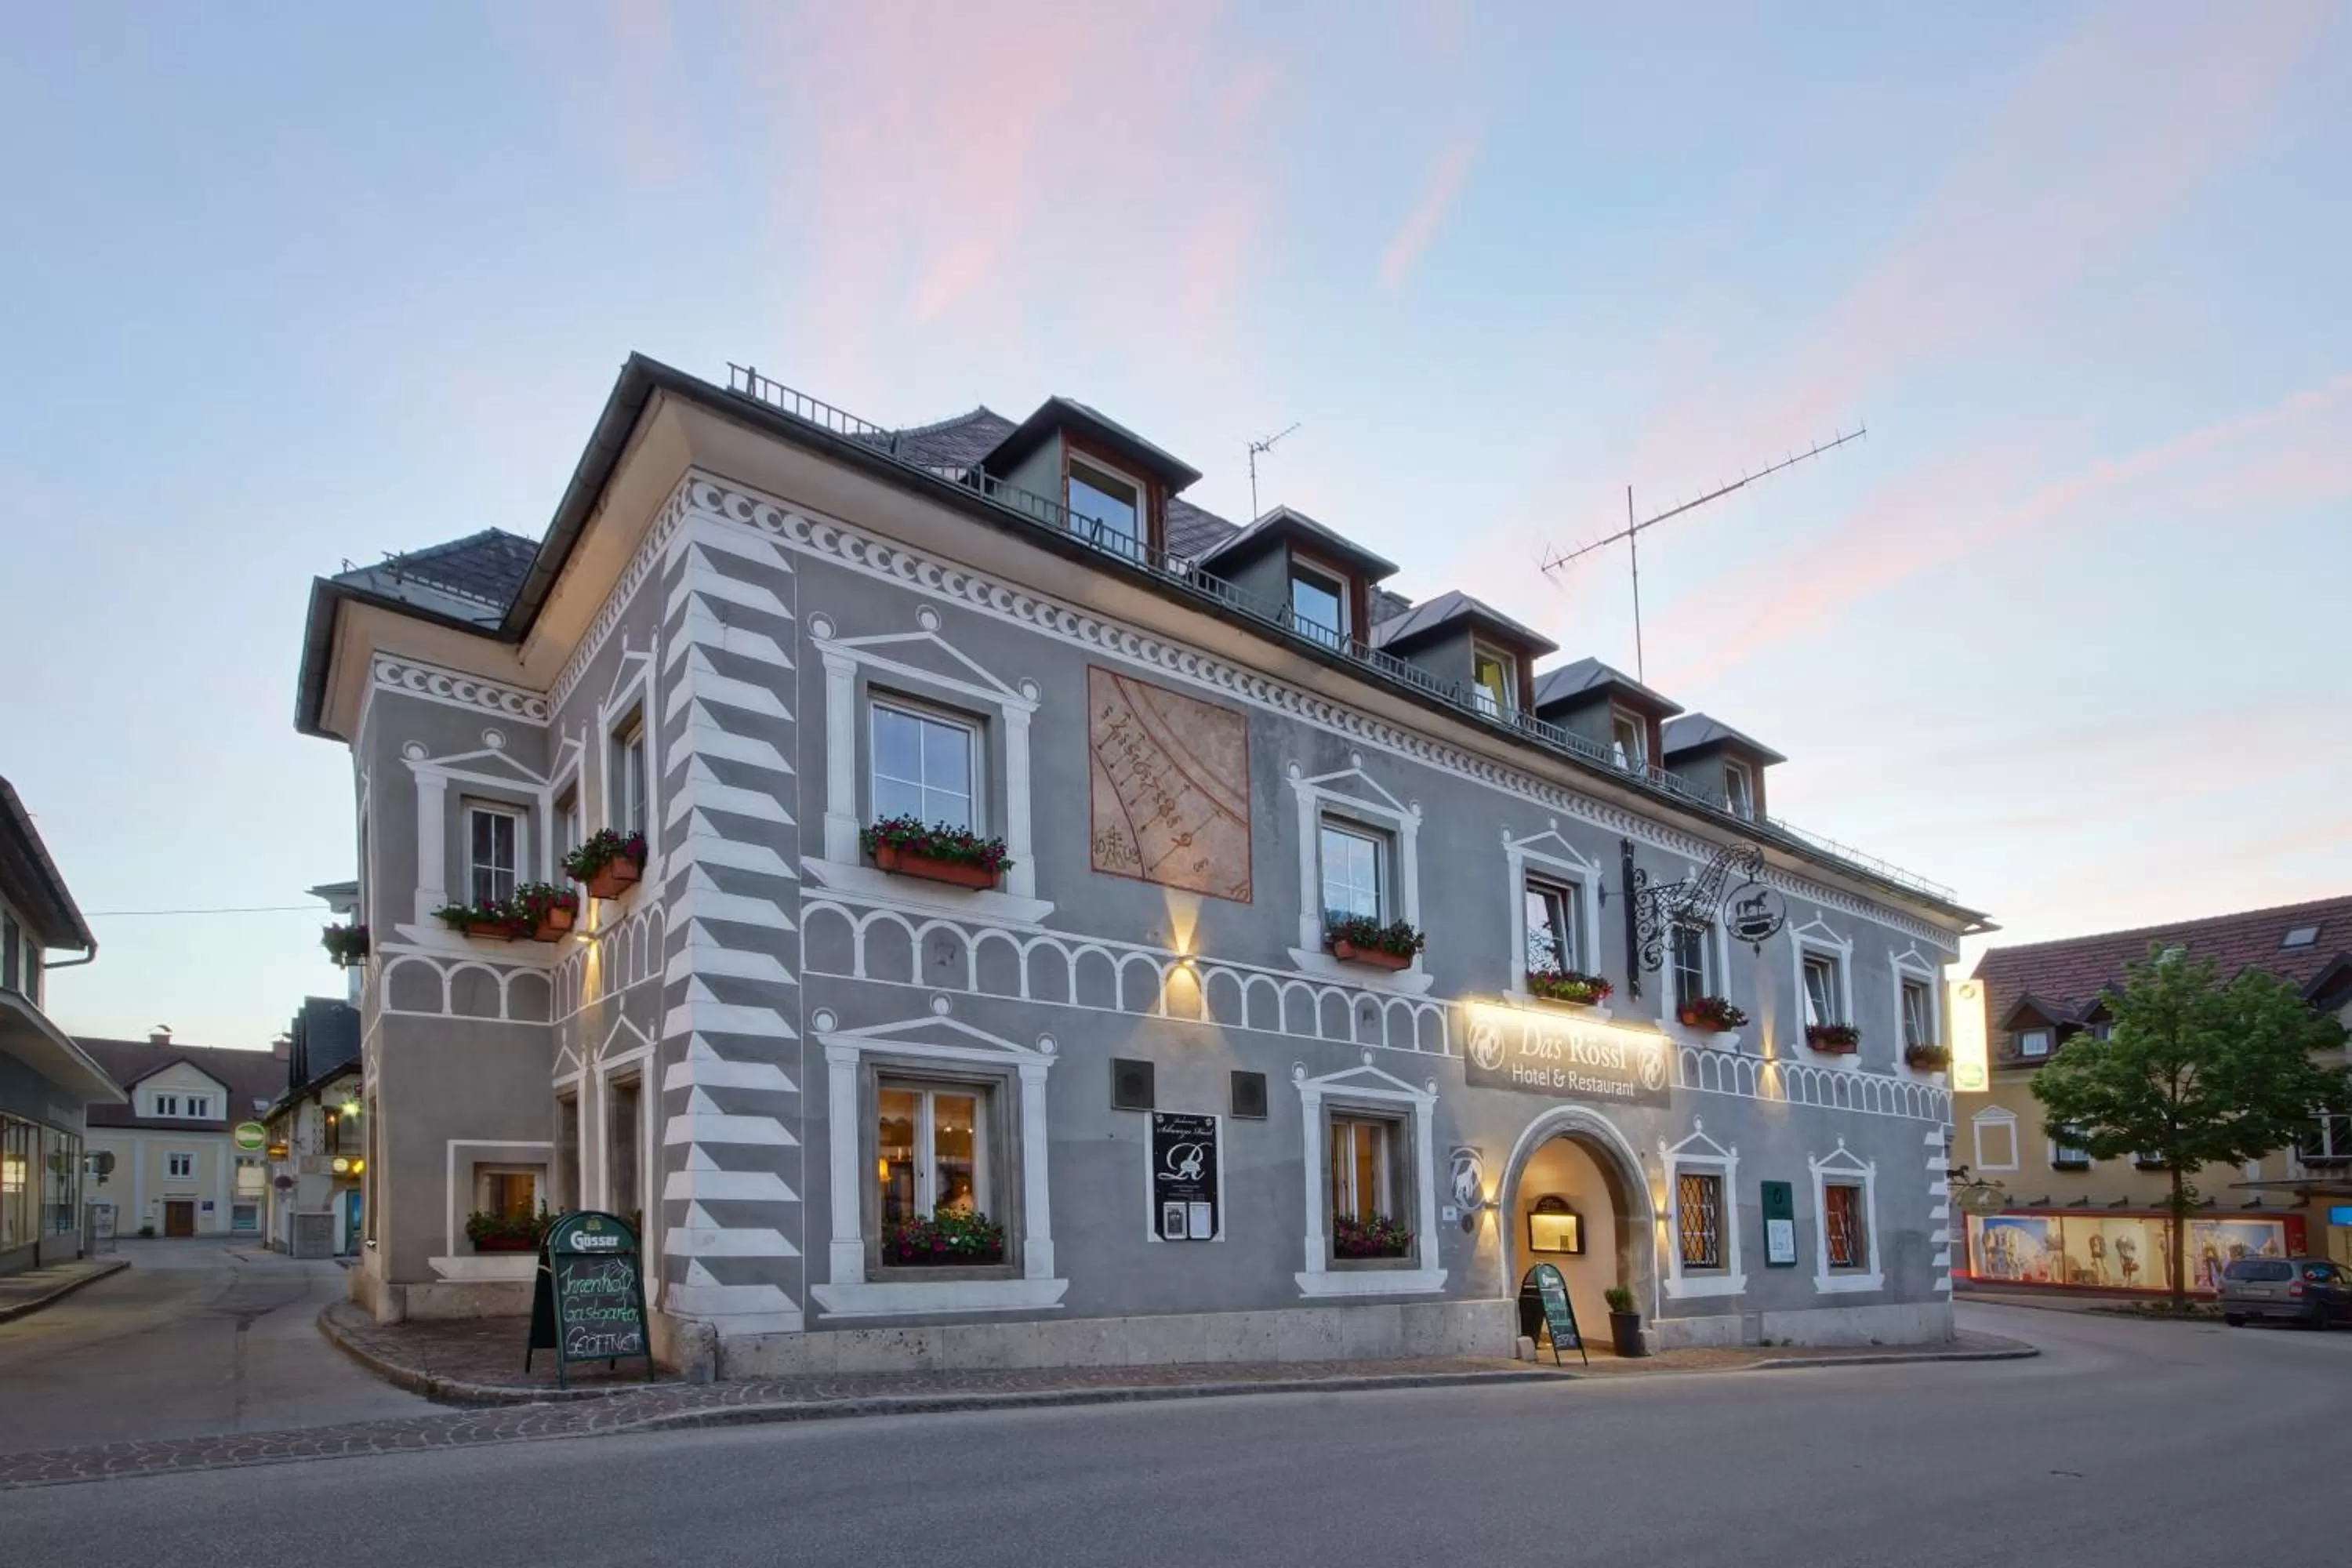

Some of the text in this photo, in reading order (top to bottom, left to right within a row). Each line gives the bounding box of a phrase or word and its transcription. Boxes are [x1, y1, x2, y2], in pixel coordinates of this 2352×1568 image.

[1519, 1022, 1627, 1070] Das Rössl
[1512, 1062, 1635, 1097] Hotel & Restaurant
[570, 1229, 619, 1250] Gösser
